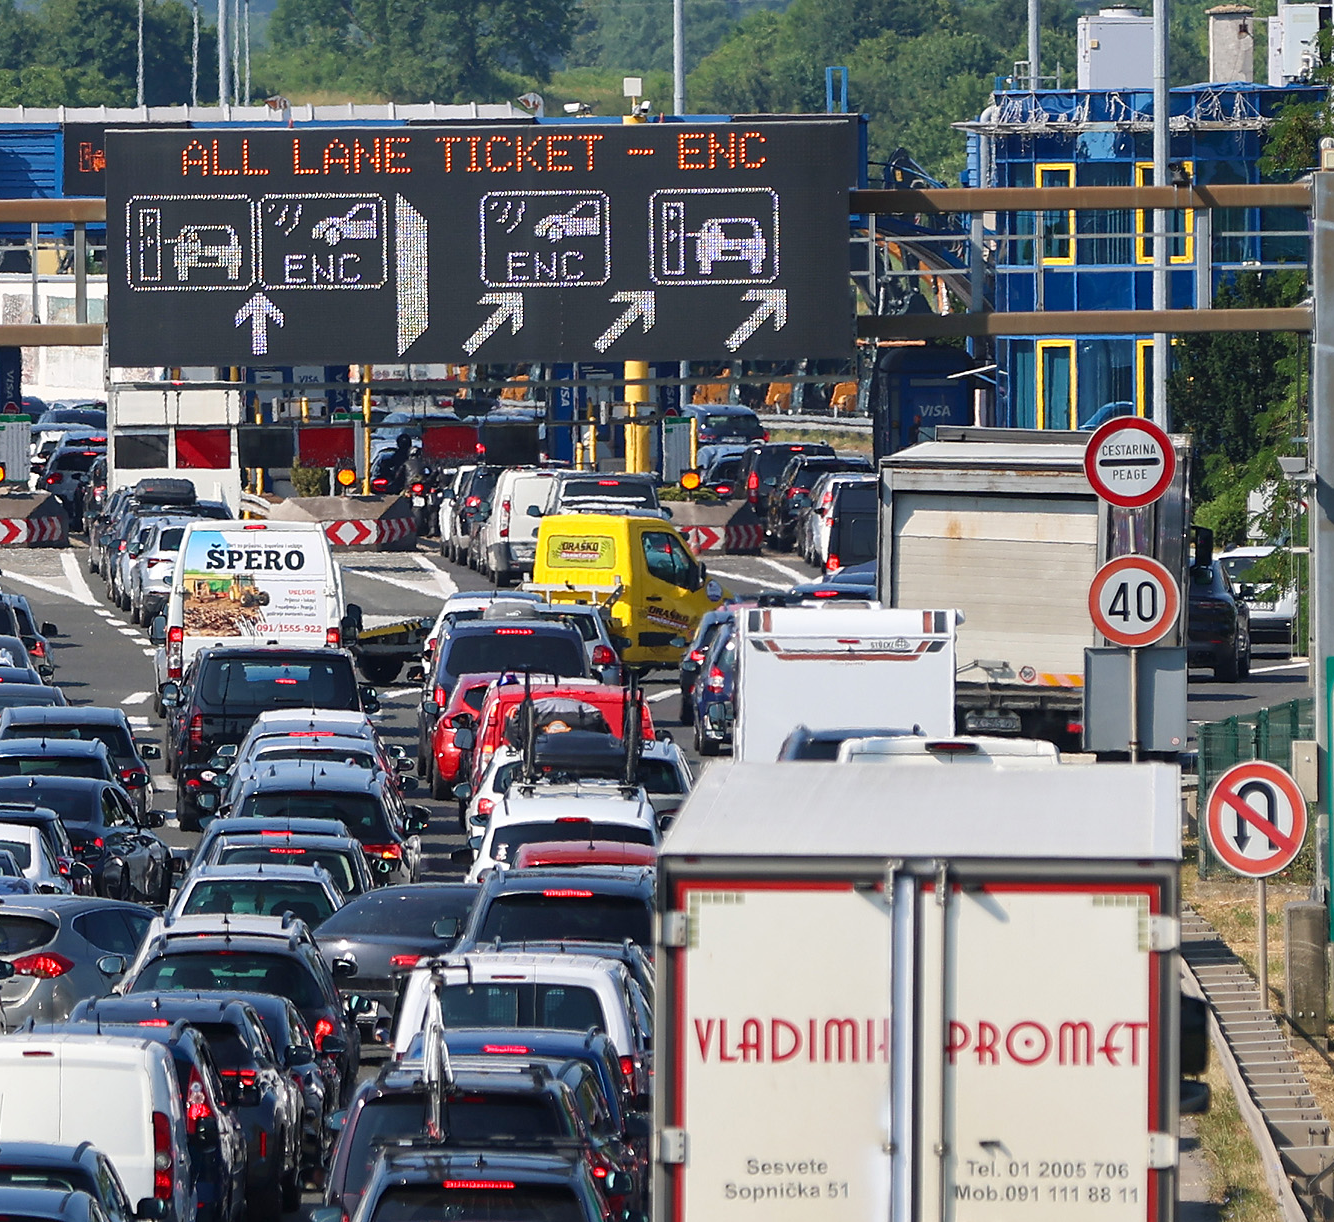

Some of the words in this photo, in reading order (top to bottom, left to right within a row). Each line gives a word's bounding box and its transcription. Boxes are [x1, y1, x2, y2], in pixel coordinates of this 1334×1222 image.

[182, 138, 270, 176] ALL
[293, 137, 411, 175] LANE
[435, 134, 604, 173] TICKET
[677, 132, 767, 170] ENC
[283, 253, 362, 284] ENC
[505, 251, 585, 282] ENC
[919, 405, 951, 417] VISA
[1102, 443, 1157, 457] CESTARINA
[1112, 468, 1148, 480] PEAGE
[206, 543, 305, 571] ŠPERO
[1108, 580, 1158, 622] 40
[945, 1019, 1148, 1067] PROMET
[746, 1158, 829, 1175] Sesvete
[966, 1160, 1002, 1178] Tel.
[1008, 1161, 1031, 1177] 01
[1038, 1161, 1088, 1179] 2005
[1093, 1162, 1130, 1179] 706
[724, 1182, 821, 1202] Sopnička
[828, 1183, 851, 1199] 51
[1048, 1185, 1081, 1202] 111
[1087, 1186, 1112, 1203] 88
[1119, 1187, 1139, 1204] 11
